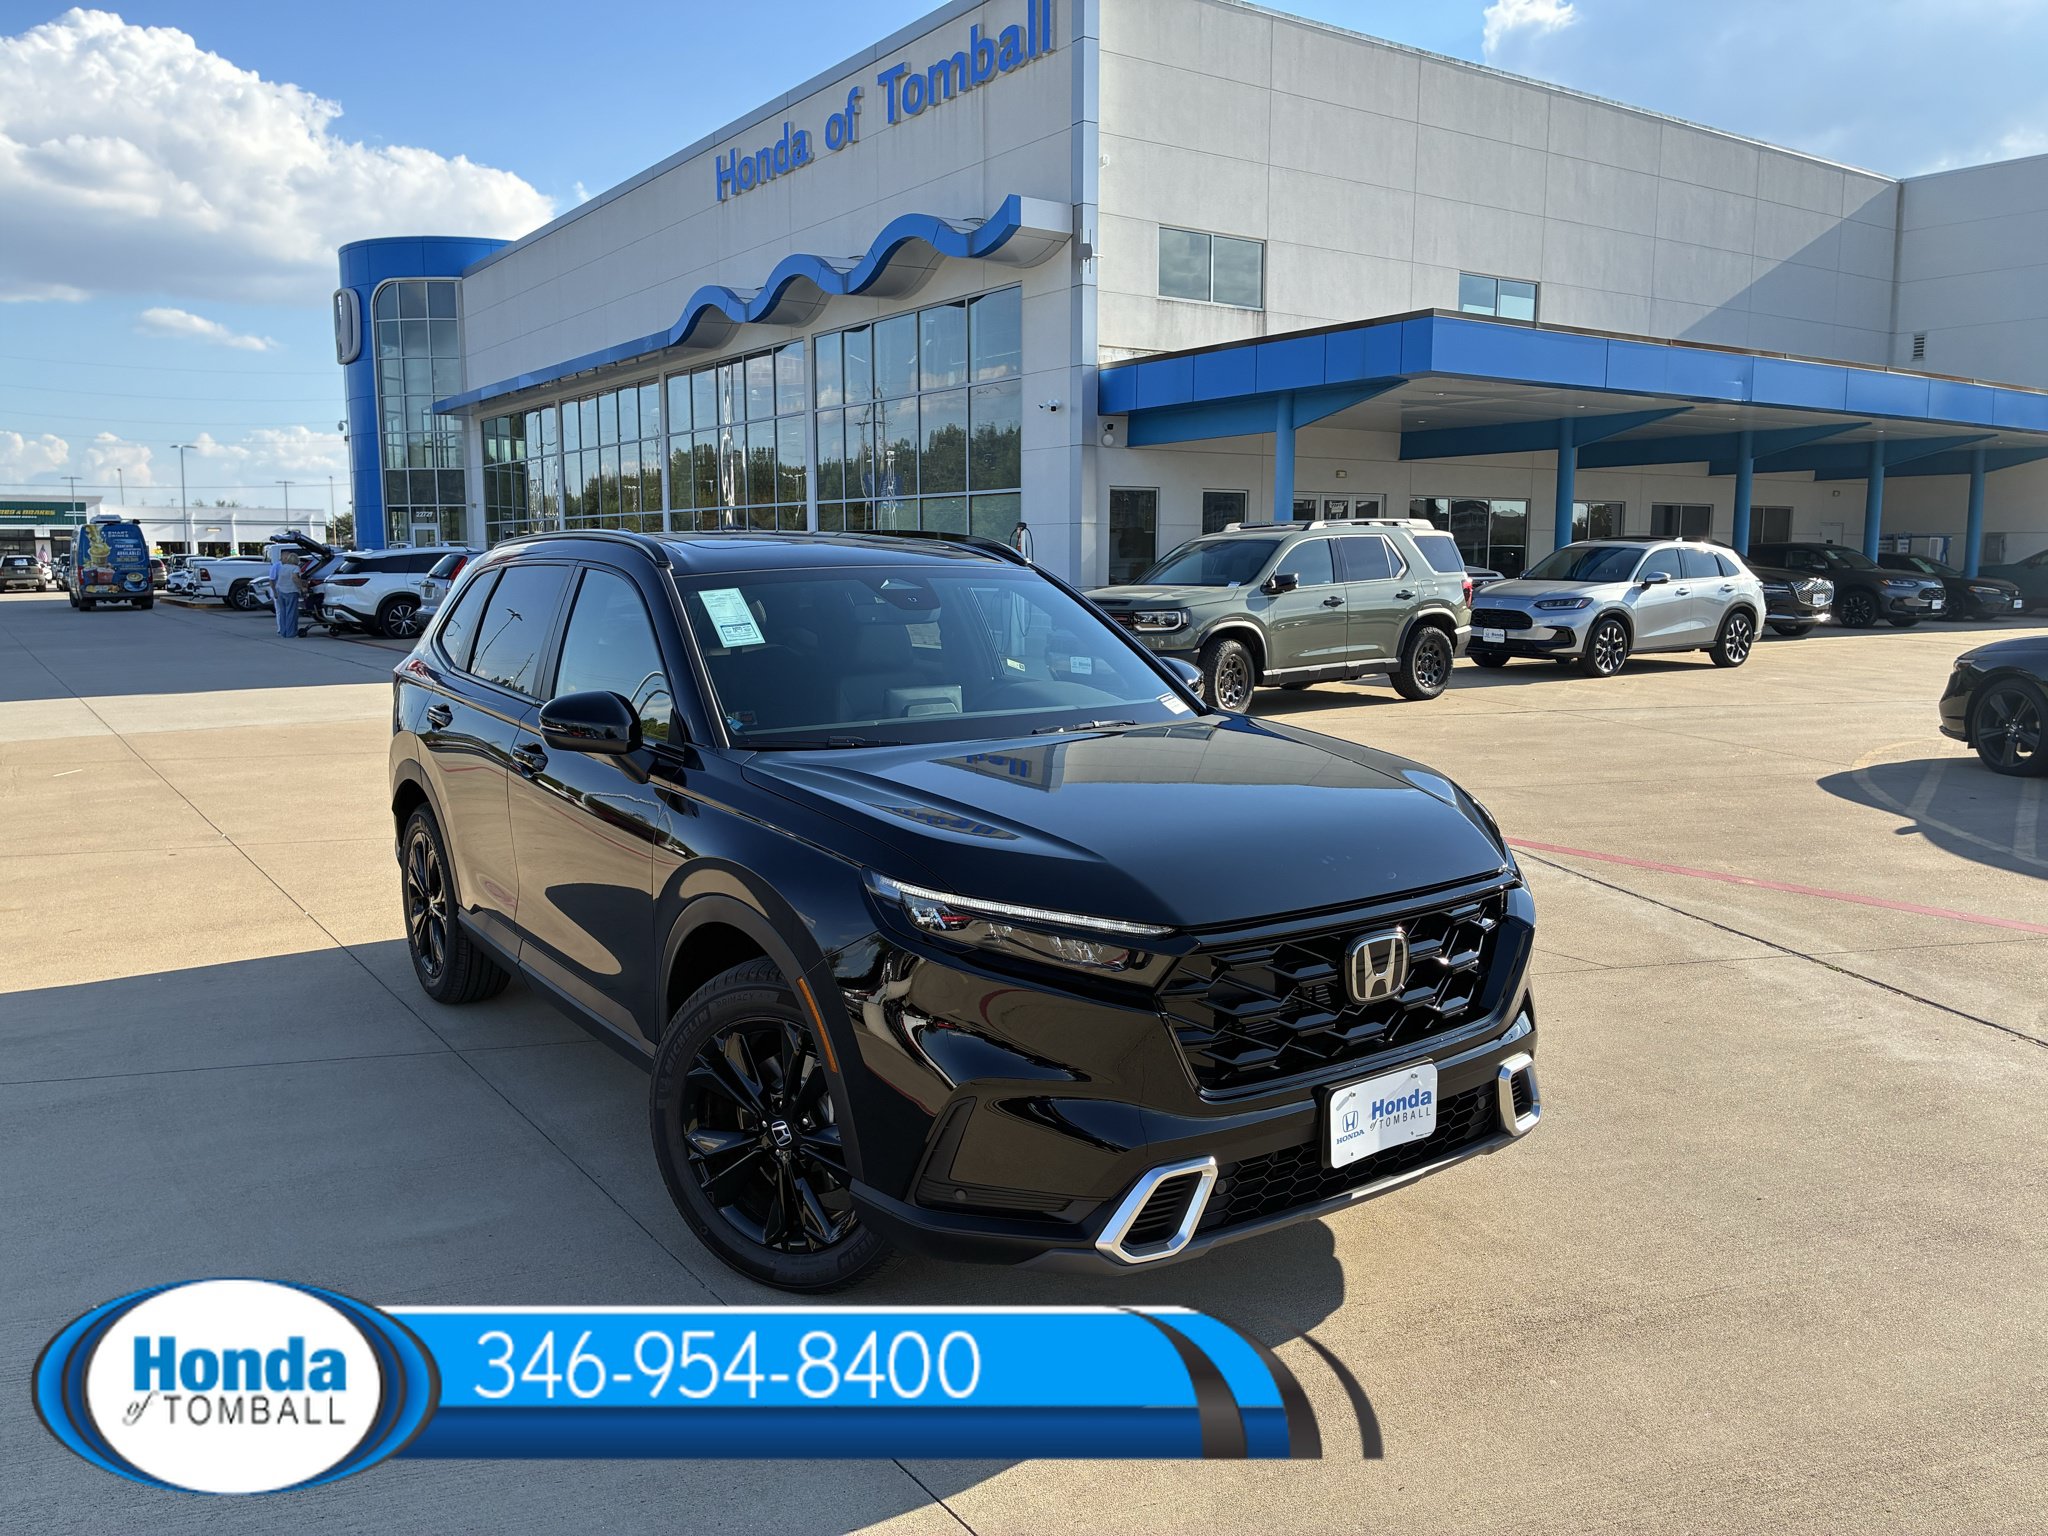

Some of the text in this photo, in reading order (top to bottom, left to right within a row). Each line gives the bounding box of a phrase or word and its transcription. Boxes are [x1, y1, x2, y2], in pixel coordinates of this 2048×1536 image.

[715, 0, 1056, 202] Honda of Tomball
[664, 1007, 710, 1075] MICHELIN
[1369, 1107, 1431, 1132] of TOMBALL
[1371, 1089, 1432, 1120] Honda
[1336, 1129, 1365, 1145] HONDA
